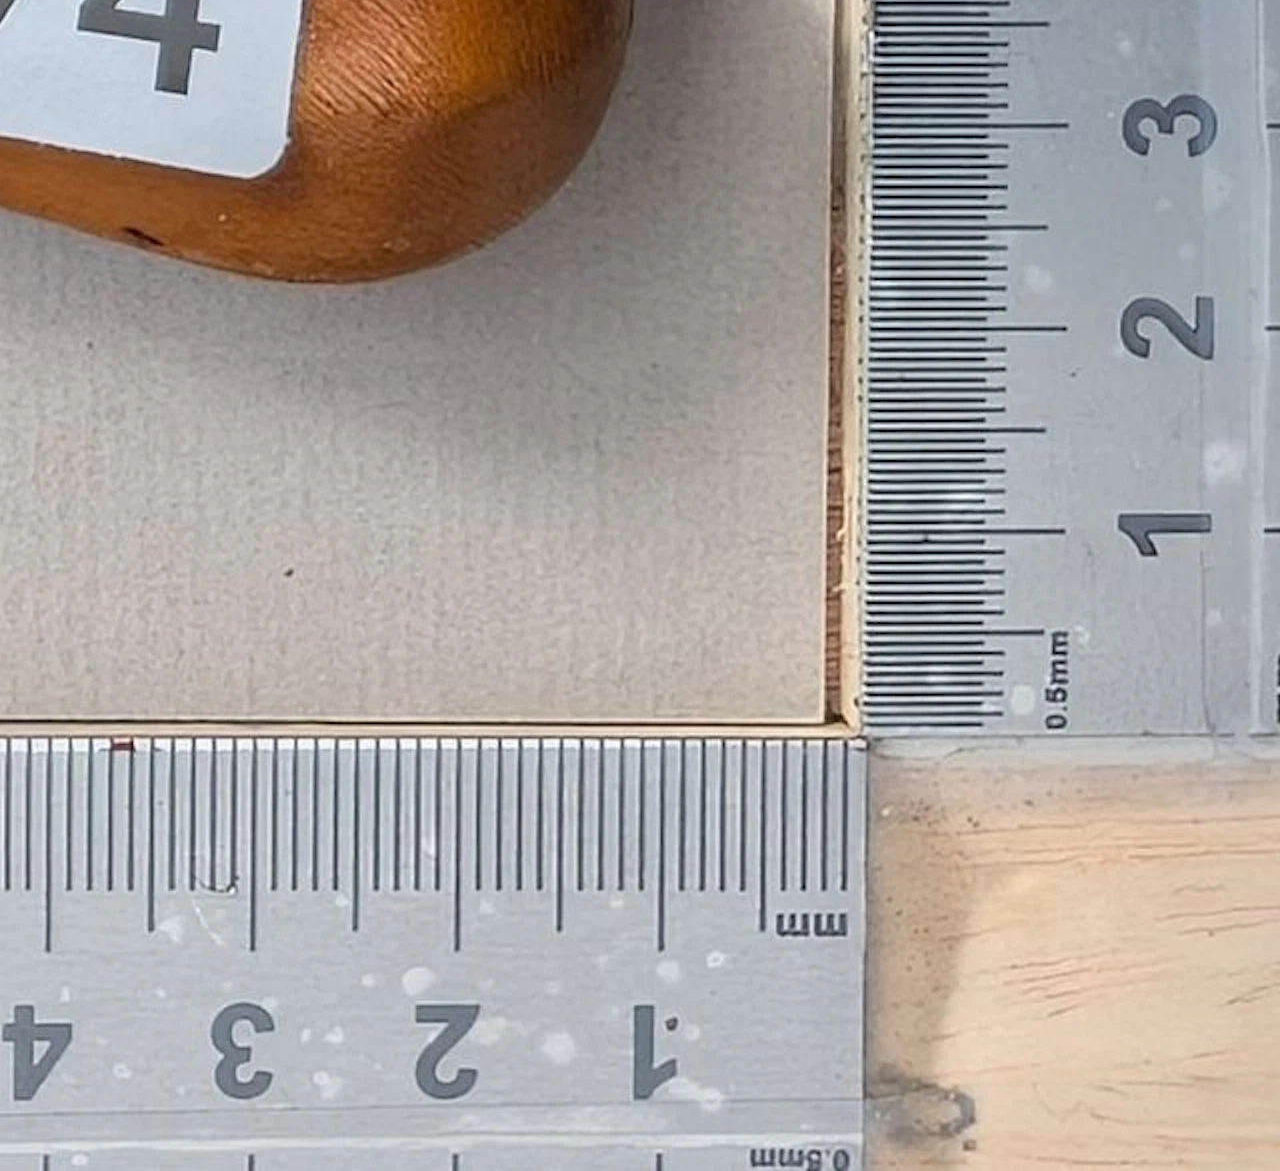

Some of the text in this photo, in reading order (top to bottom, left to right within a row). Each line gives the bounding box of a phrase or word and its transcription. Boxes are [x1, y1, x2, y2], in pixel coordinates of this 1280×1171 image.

[1122, 93, 1218, 157] 3
[1120, 296, 1214, 361] 2
[1118, 513, 1212, 557] 1
[1045, 630, 1070, 730] 0.5mm
[775, 912, 848, 938] mm
[2, 1005, 73, 1101] 4
[211, 1002, 275, 1100] 3
[415, 1004, 481, 1100] 2
[633, 1004, 678, 1101] 1
